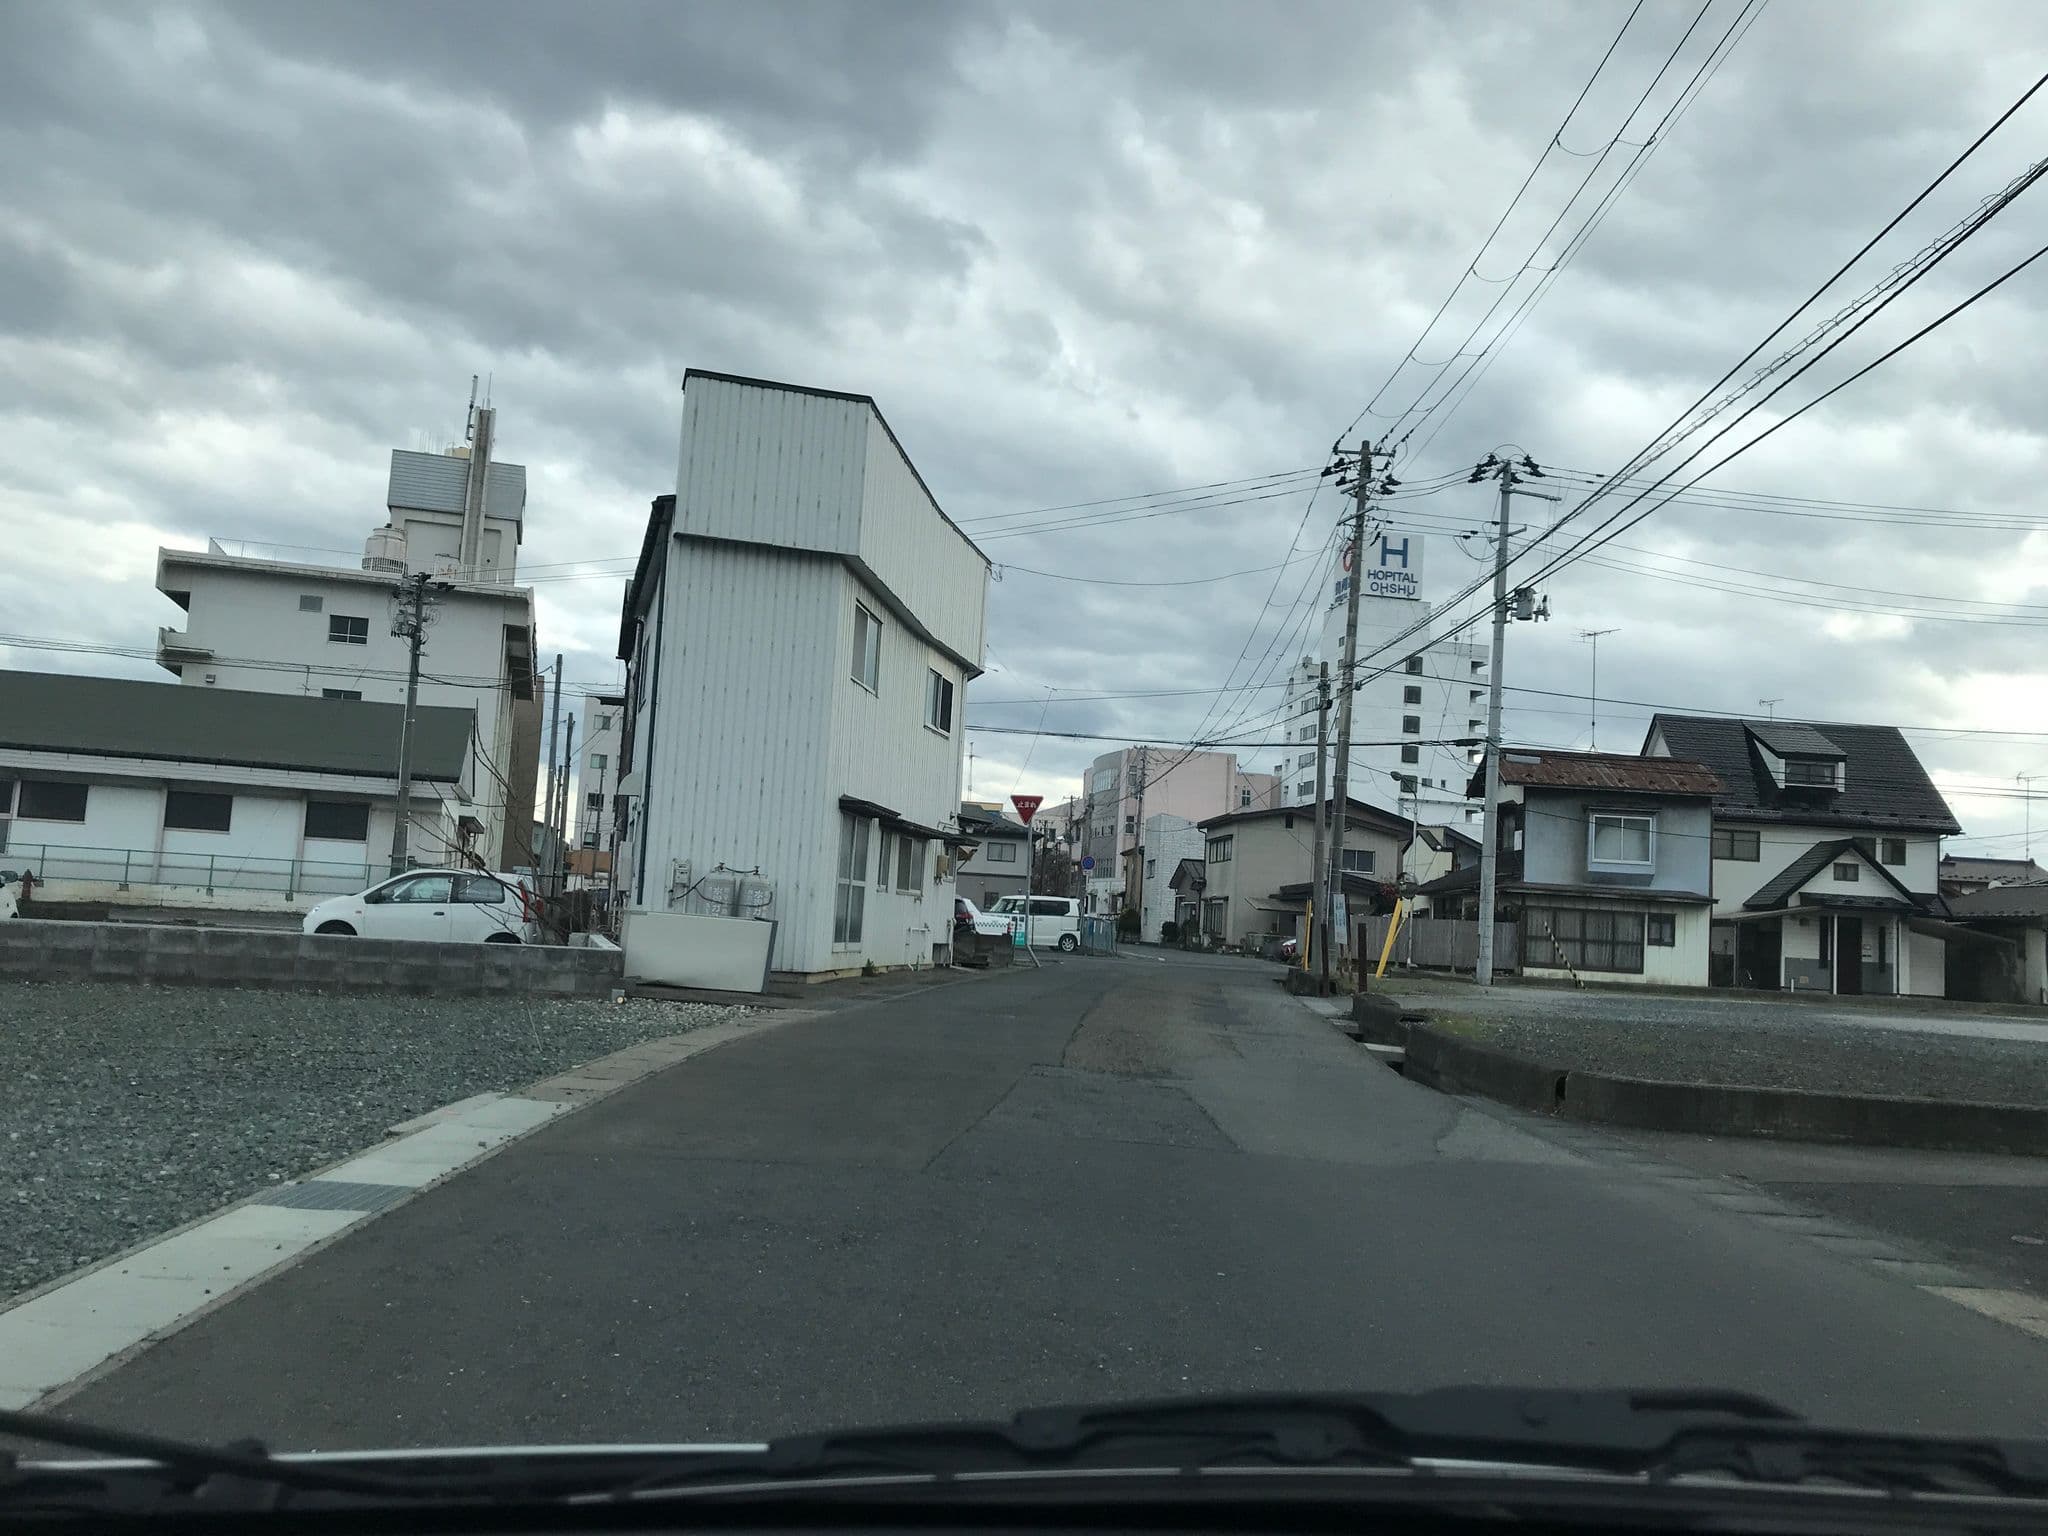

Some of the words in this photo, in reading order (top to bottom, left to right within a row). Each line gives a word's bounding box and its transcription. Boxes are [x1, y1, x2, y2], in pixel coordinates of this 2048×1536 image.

[1381, 535, 1409, 568] H
[1367, 569, 1419, 584] HOPITAL
[1370, 581, 1416, 595] OHSHU
[1017, 800, 1037, 809] 止まれ
